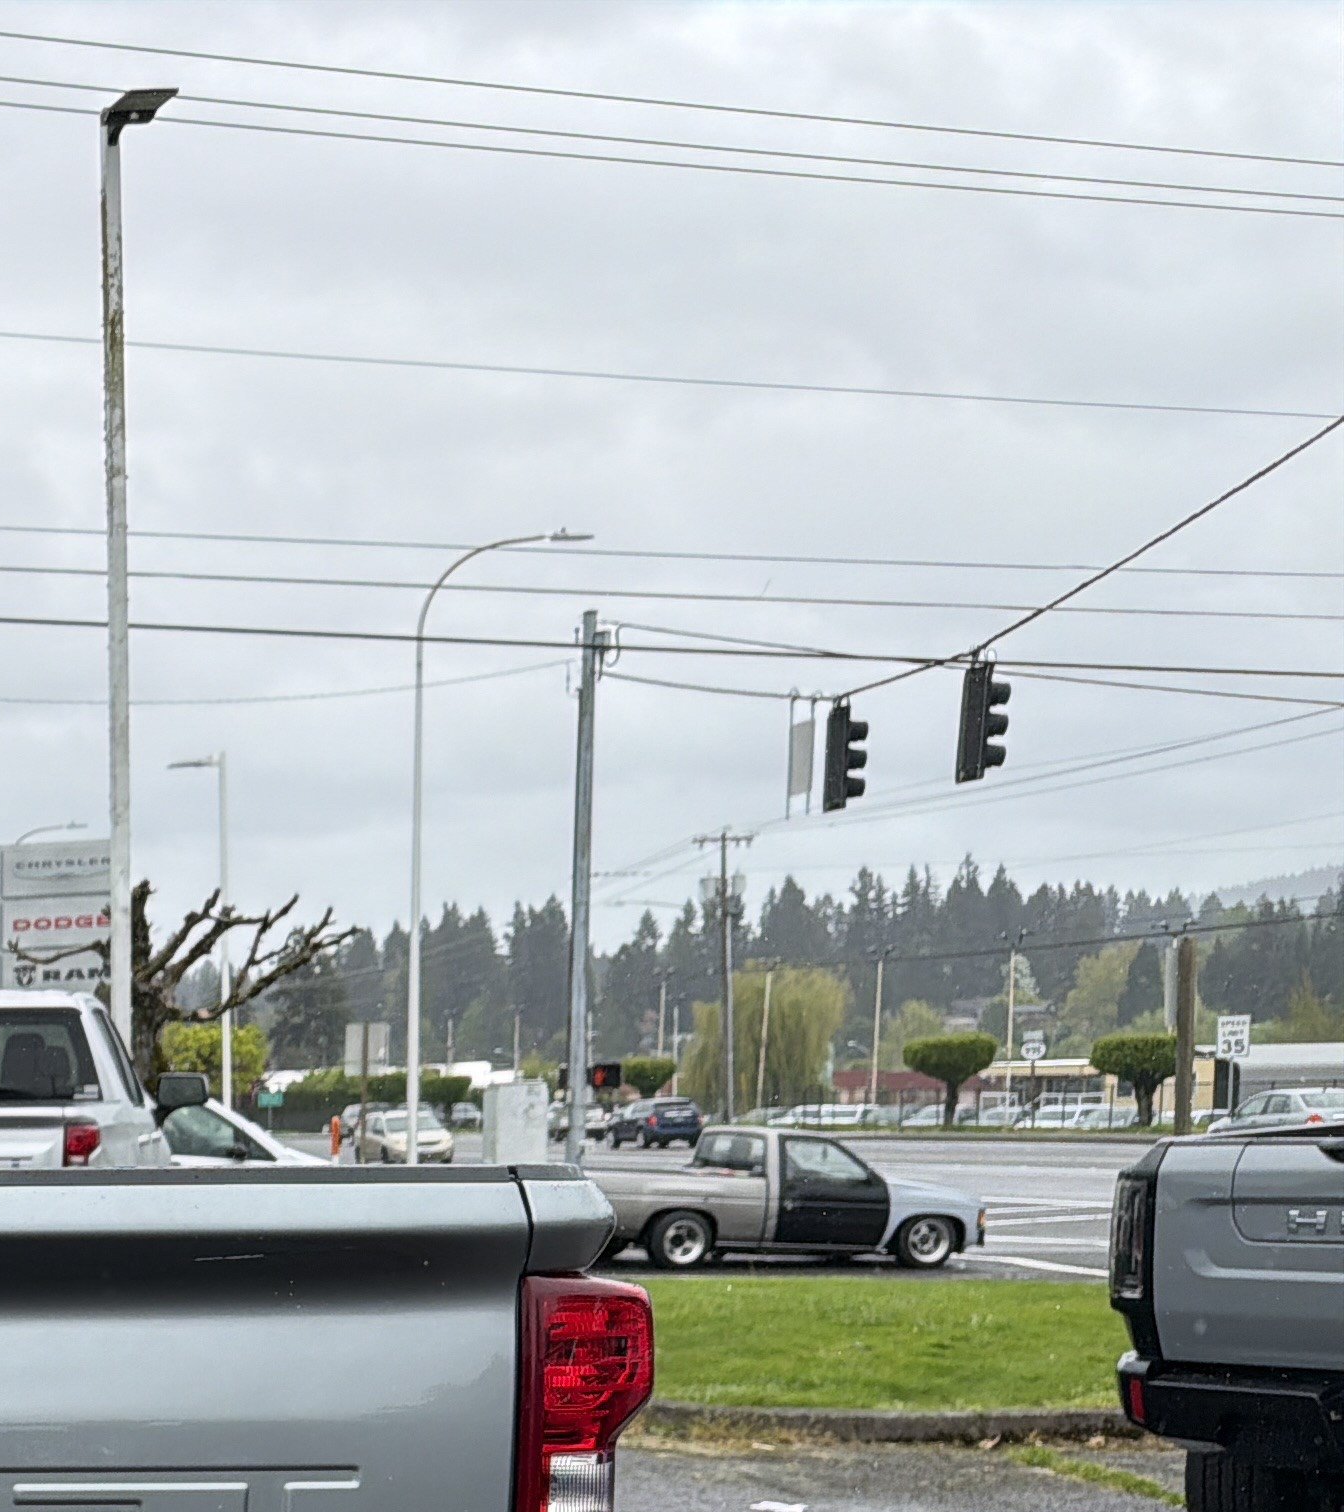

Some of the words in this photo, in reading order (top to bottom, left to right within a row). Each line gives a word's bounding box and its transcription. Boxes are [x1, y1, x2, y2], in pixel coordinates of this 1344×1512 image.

[15, 857, 111, 870] CHRYSLER
[13, 914, 110, 931] DODGE
[1221, 1039, 1245, 1054] 35
